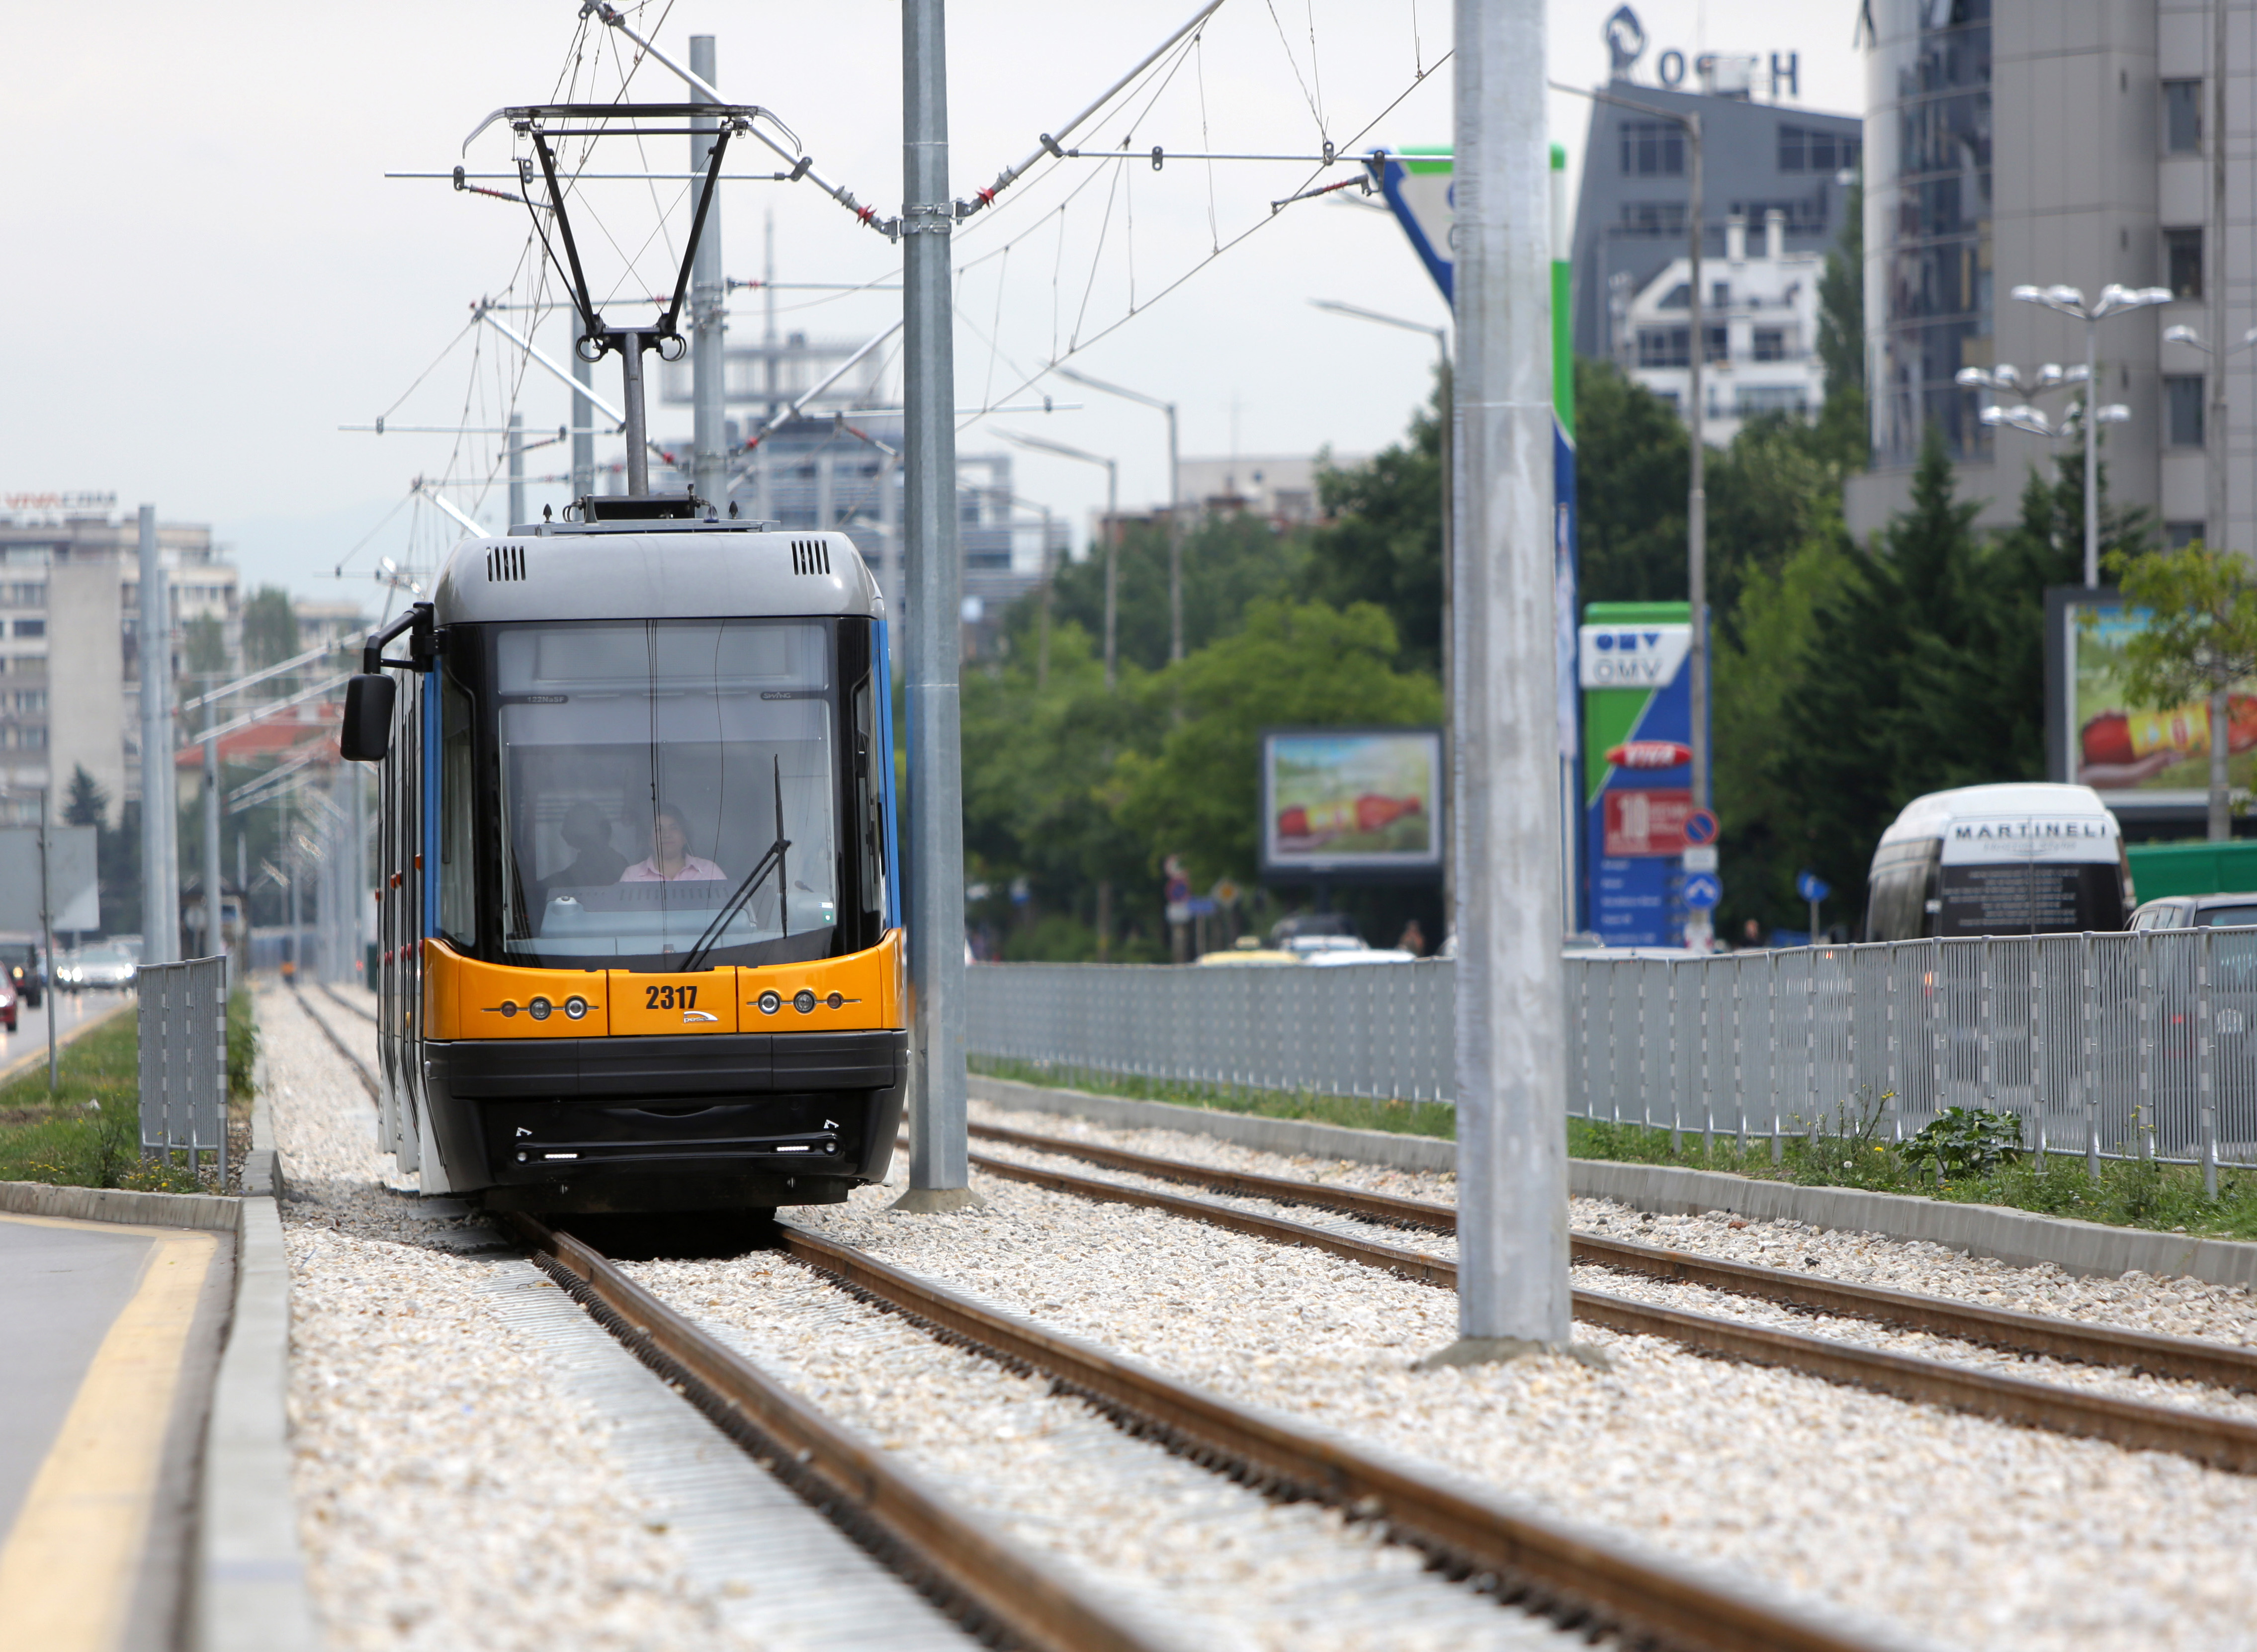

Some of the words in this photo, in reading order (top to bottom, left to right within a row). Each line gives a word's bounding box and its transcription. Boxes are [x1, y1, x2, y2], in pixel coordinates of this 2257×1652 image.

[1593, 659, 1663, 684] OMV
[1957, 823, 2105, 839] MARTINELI
[646, 986, 697, 1009] 2317
